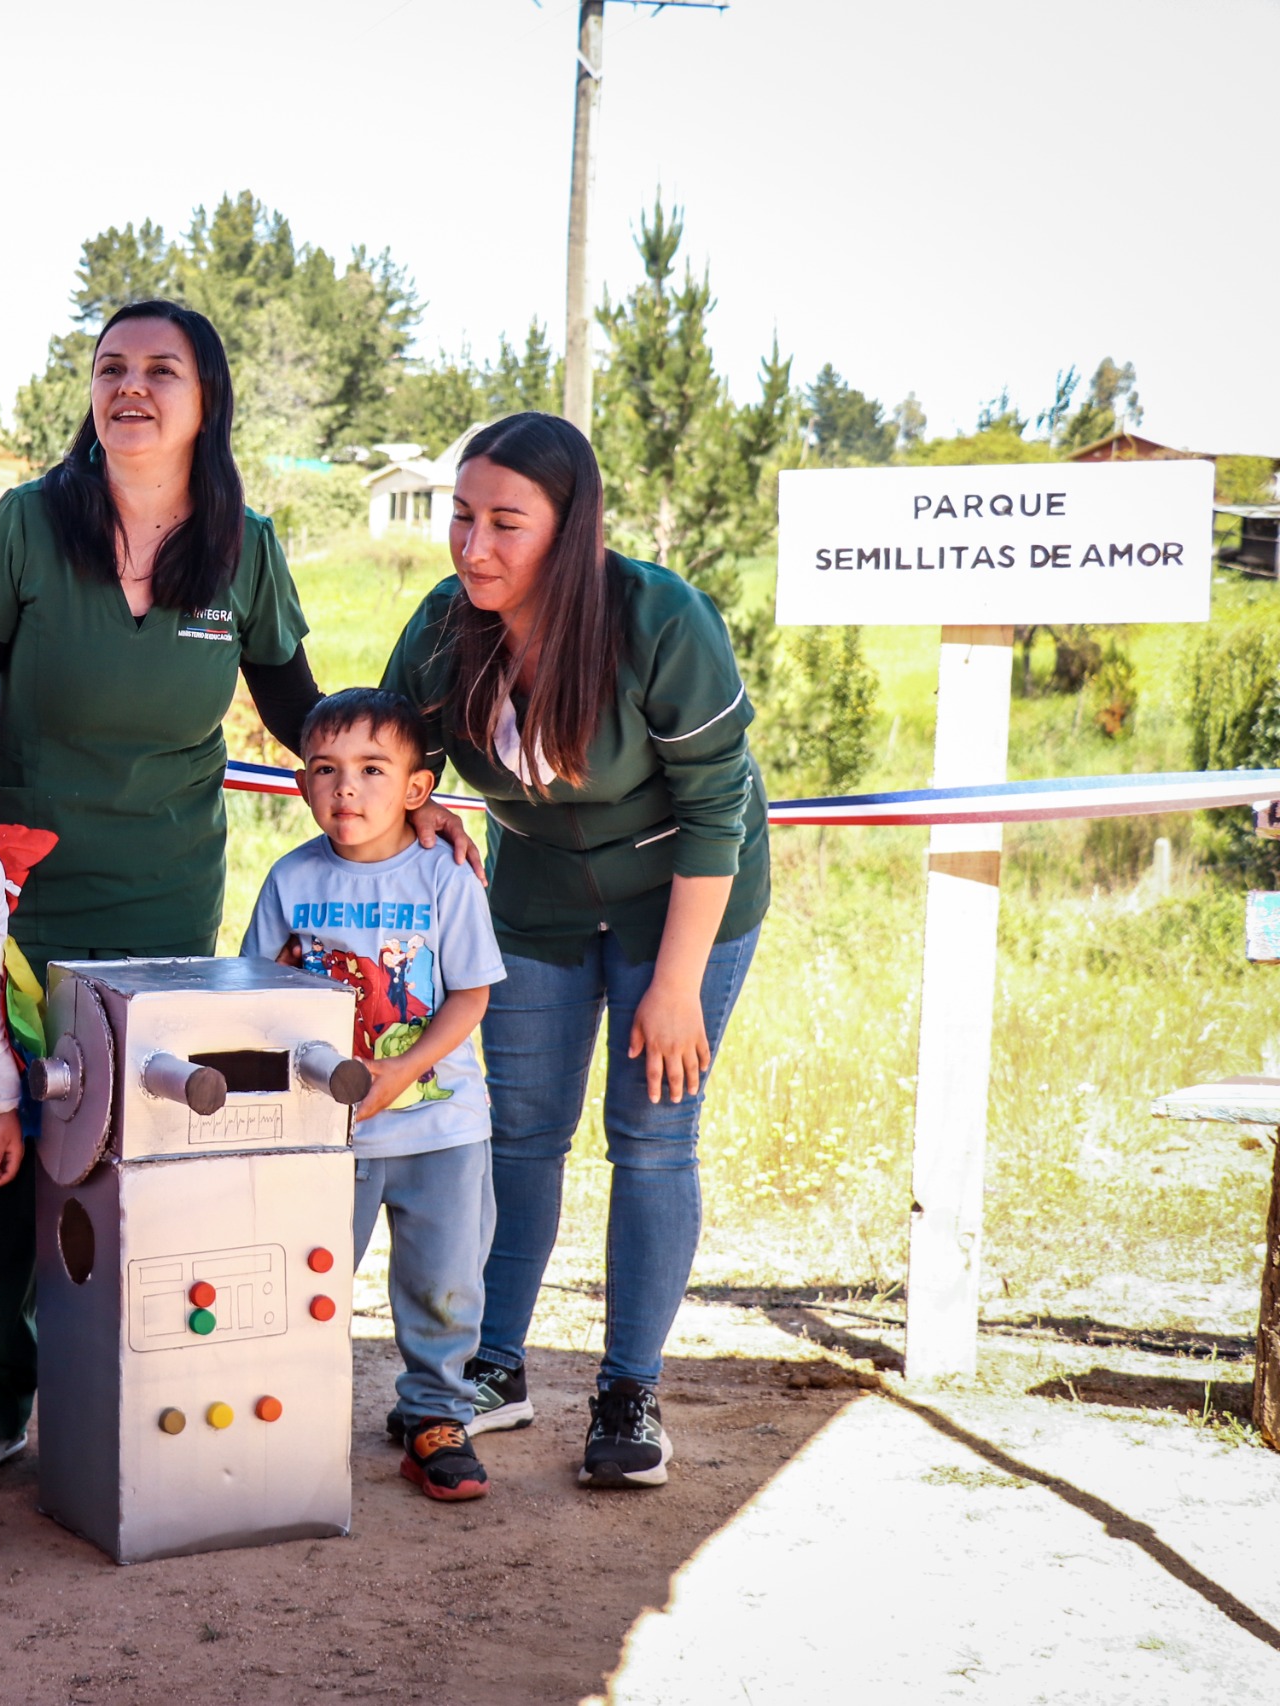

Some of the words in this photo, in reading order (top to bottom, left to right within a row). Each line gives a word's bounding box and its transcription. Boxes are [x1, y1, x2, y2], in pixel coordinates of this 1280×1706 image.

[913, 492, 1067, 519] PARQUE
[815, 544, 1016, 571] SEMILLITAS
[1030, 544, 1072, 569] DE
[1079, 542, 1185, 568] AMOR
[292, 901, 431, 931] AVENGERS
